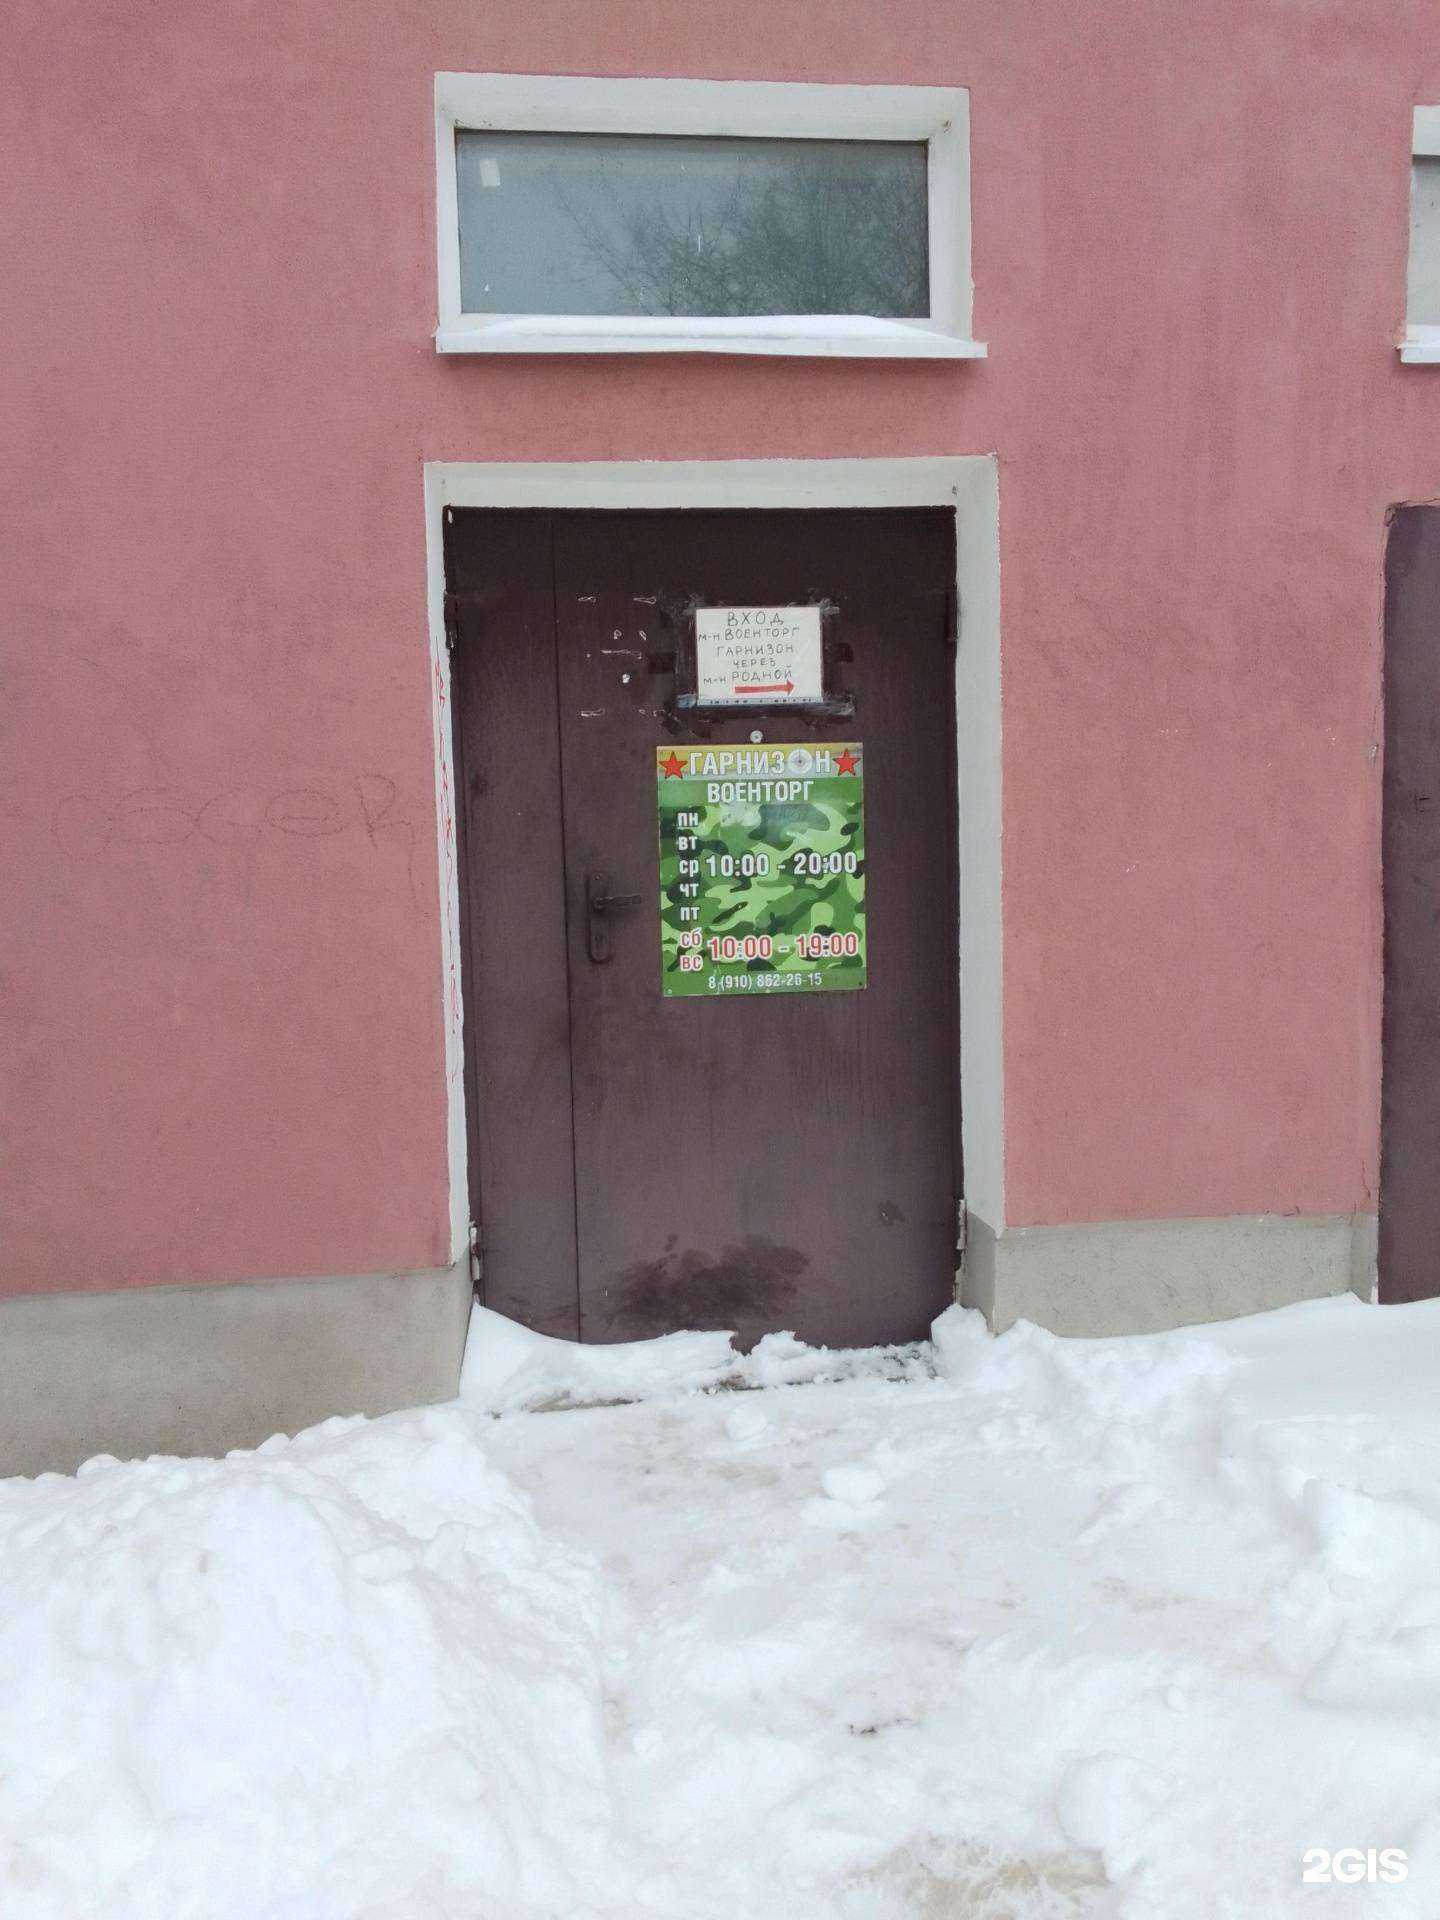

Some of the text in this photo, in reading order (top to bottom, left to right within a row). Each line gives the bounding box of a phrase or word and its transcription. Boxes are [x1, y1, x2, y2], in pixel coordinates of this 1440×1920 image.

[727, 611, 784, 627] ВХОД
[725, 627, 800, 641] ВОЕНТОРГ
[733, 658, 777, 668] ЧЕРЕЗ
[731, 665, 793, 682] РОДНОЙ
[689, 748, 832, 776] ГАРНИЗОН
[707, 781, 815, 804] ВОЕНТОРГ
[706, 853, 770, 877] 10:00
[793, 852, 858, 875] 20:00
[708, 935, 773, 961] 10:00
[795, 932, 859, 957] 19:00
[720, 974, 752, 990] (910)
[756, 972, 823, 988] 862-26-15
